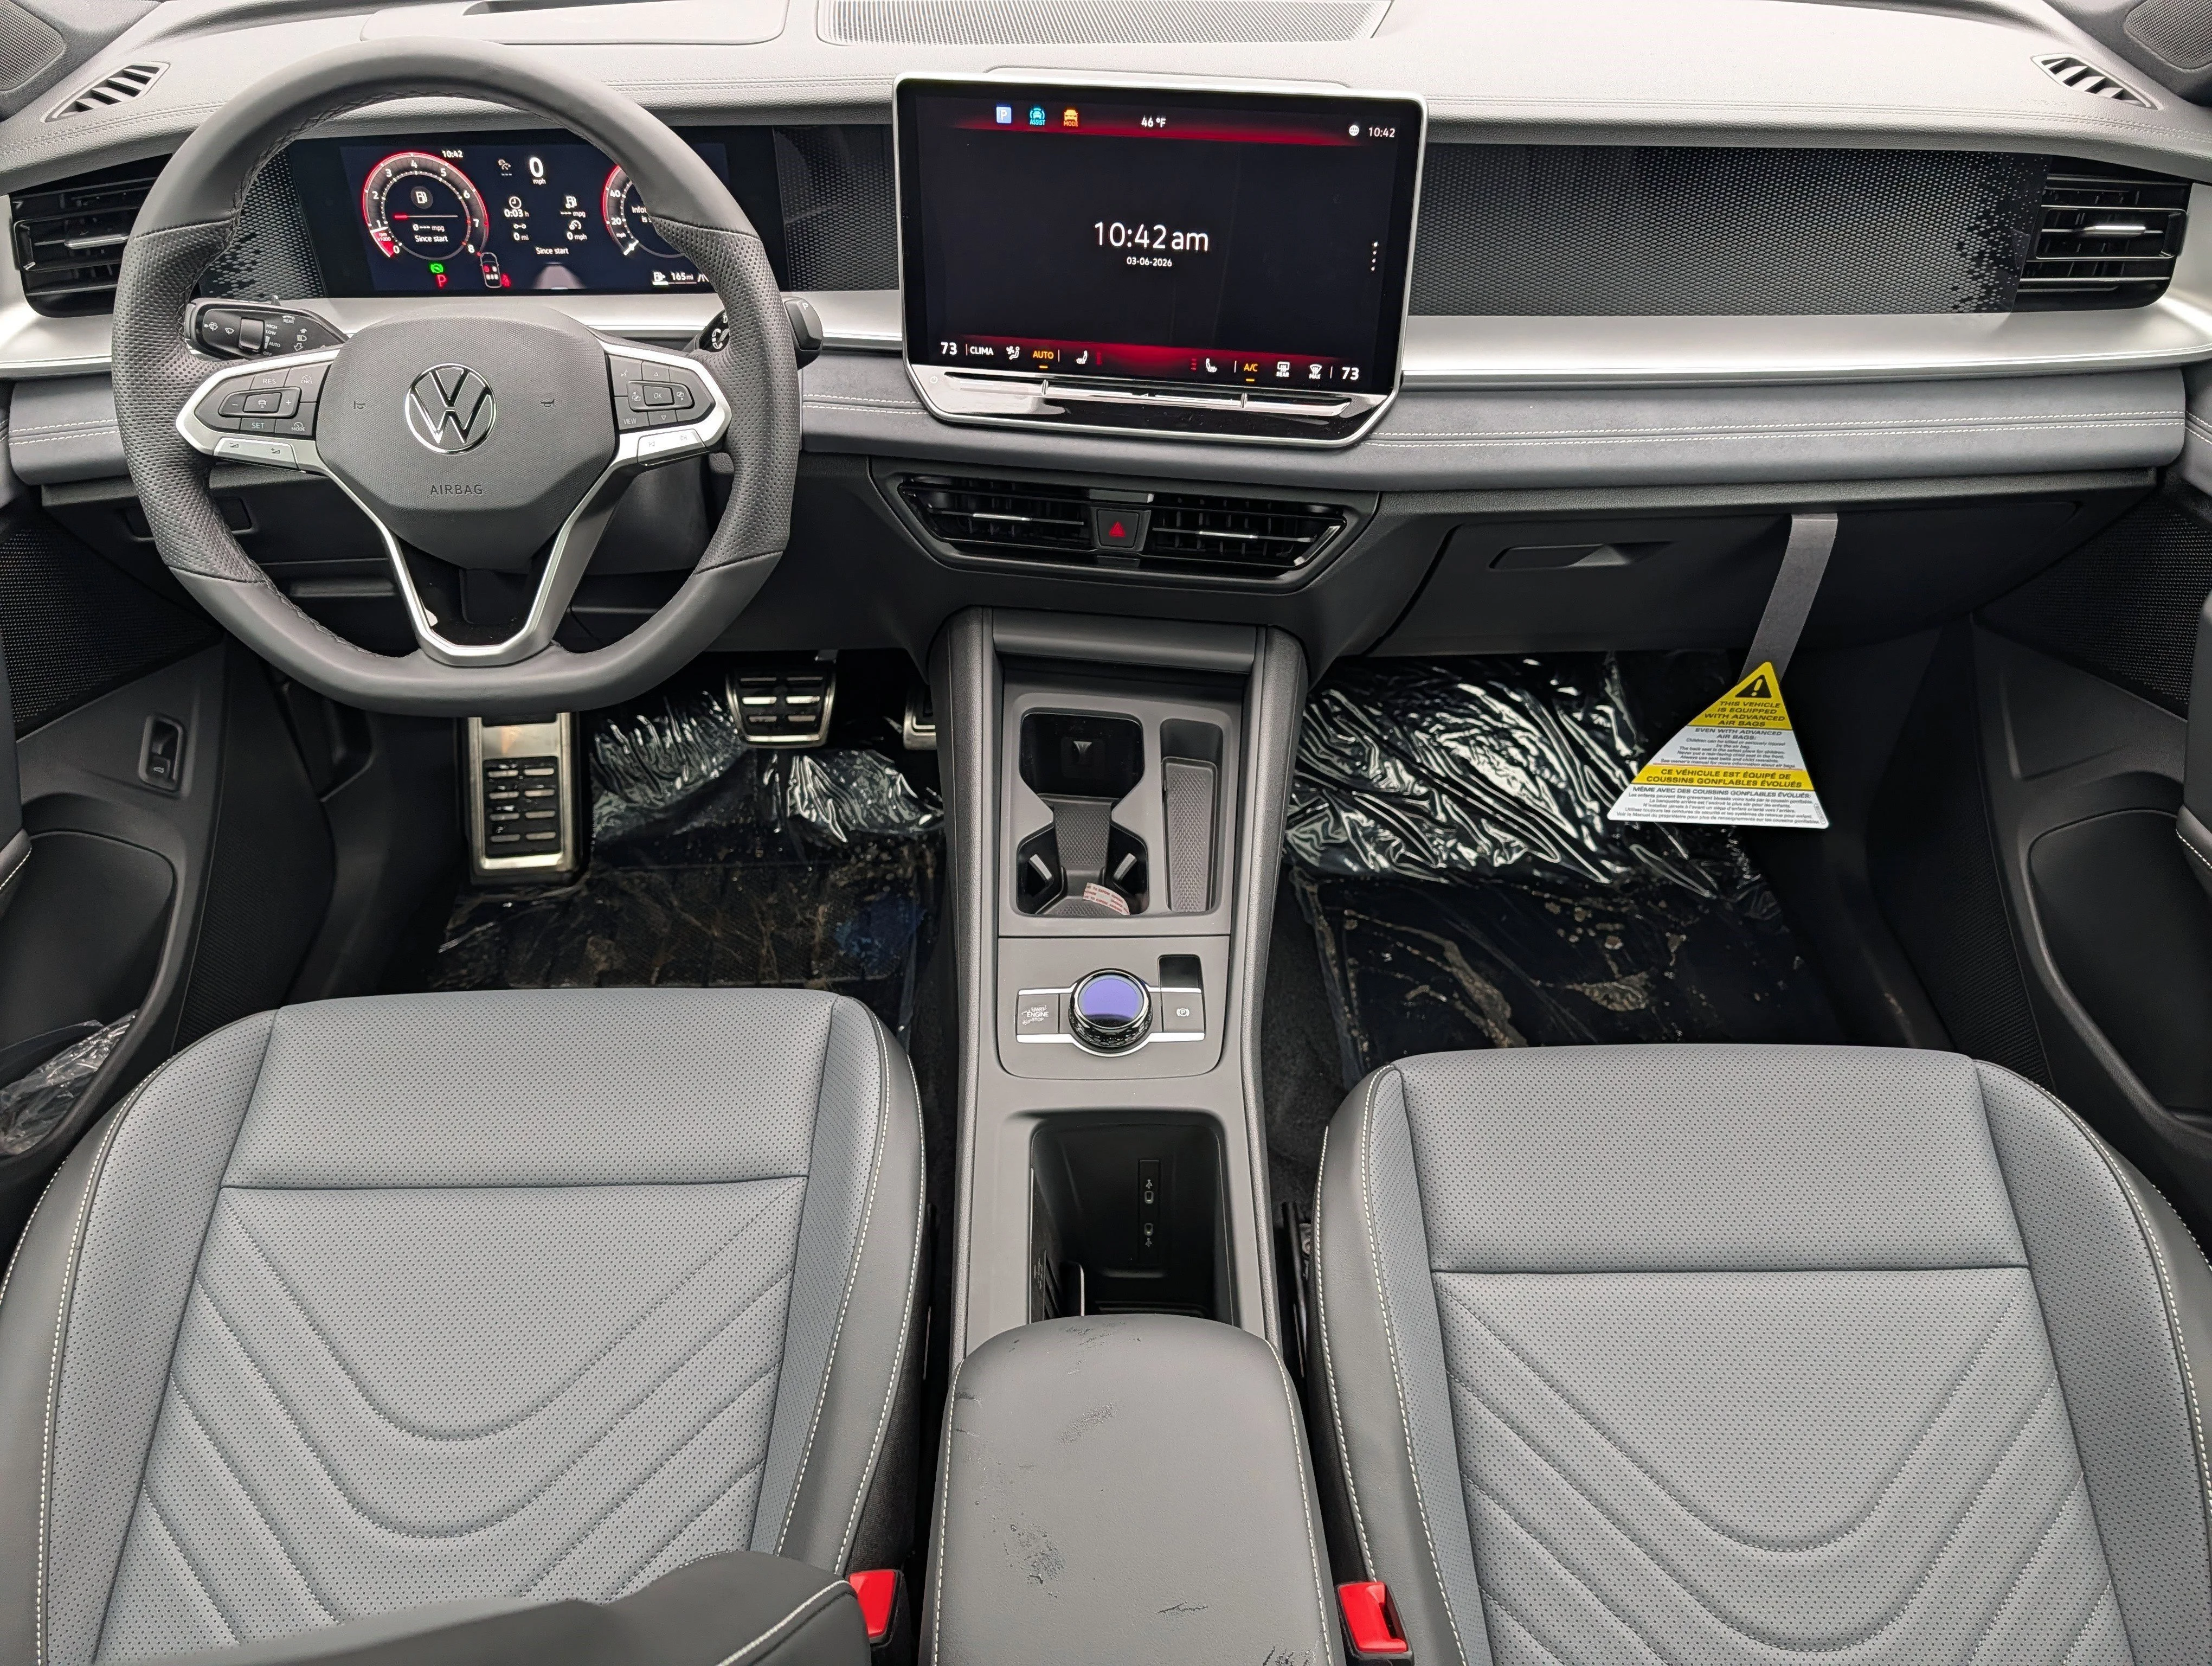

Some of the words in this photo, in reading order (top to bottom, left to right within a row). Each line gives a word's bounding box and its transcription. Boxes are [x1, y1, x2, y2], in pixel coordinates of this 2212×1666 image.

[1141, 117, 1154, 127] 46
[1368, 126, 1396, 138] 10:42
[411, 160, 417, 169] 4
[529, 157, 543, 177] 0
[386, 169, 391, 177] 3
[440, 168, 446, 177] 5
[372, 191, 379, 200] 2
[464, 190, 471, 198] 6
[504, 209, 524, 217] 0:03
[473, 219, 479, 227] 7
[513, 232, 520, 241] 0
[567, 232, 573, 240] 0
[393, 245, 400, 253] 0
[468, 245, 474, 253] 8
[1127, 257, 1172, 267] 03-06-2026
[437, 274, 447, 287] P
[802, 303, 808, 311] P
[941, 342, 957, 355] 73
[970, 345, 994, 355] CLIMA
[1033, 350, 1054, 359] AUTO
[1244, 363, 1258, 372] A/C
[1342, 367, 1359, 380] 73
[430, 484, 483, 496] AIRBAG
[1676, 768, 1720, 777] VÉHICULE
[1697, 778, 1758, 786] GONFLABLES
[1760, 779, 1802, 787] ÉVOLUÉS
